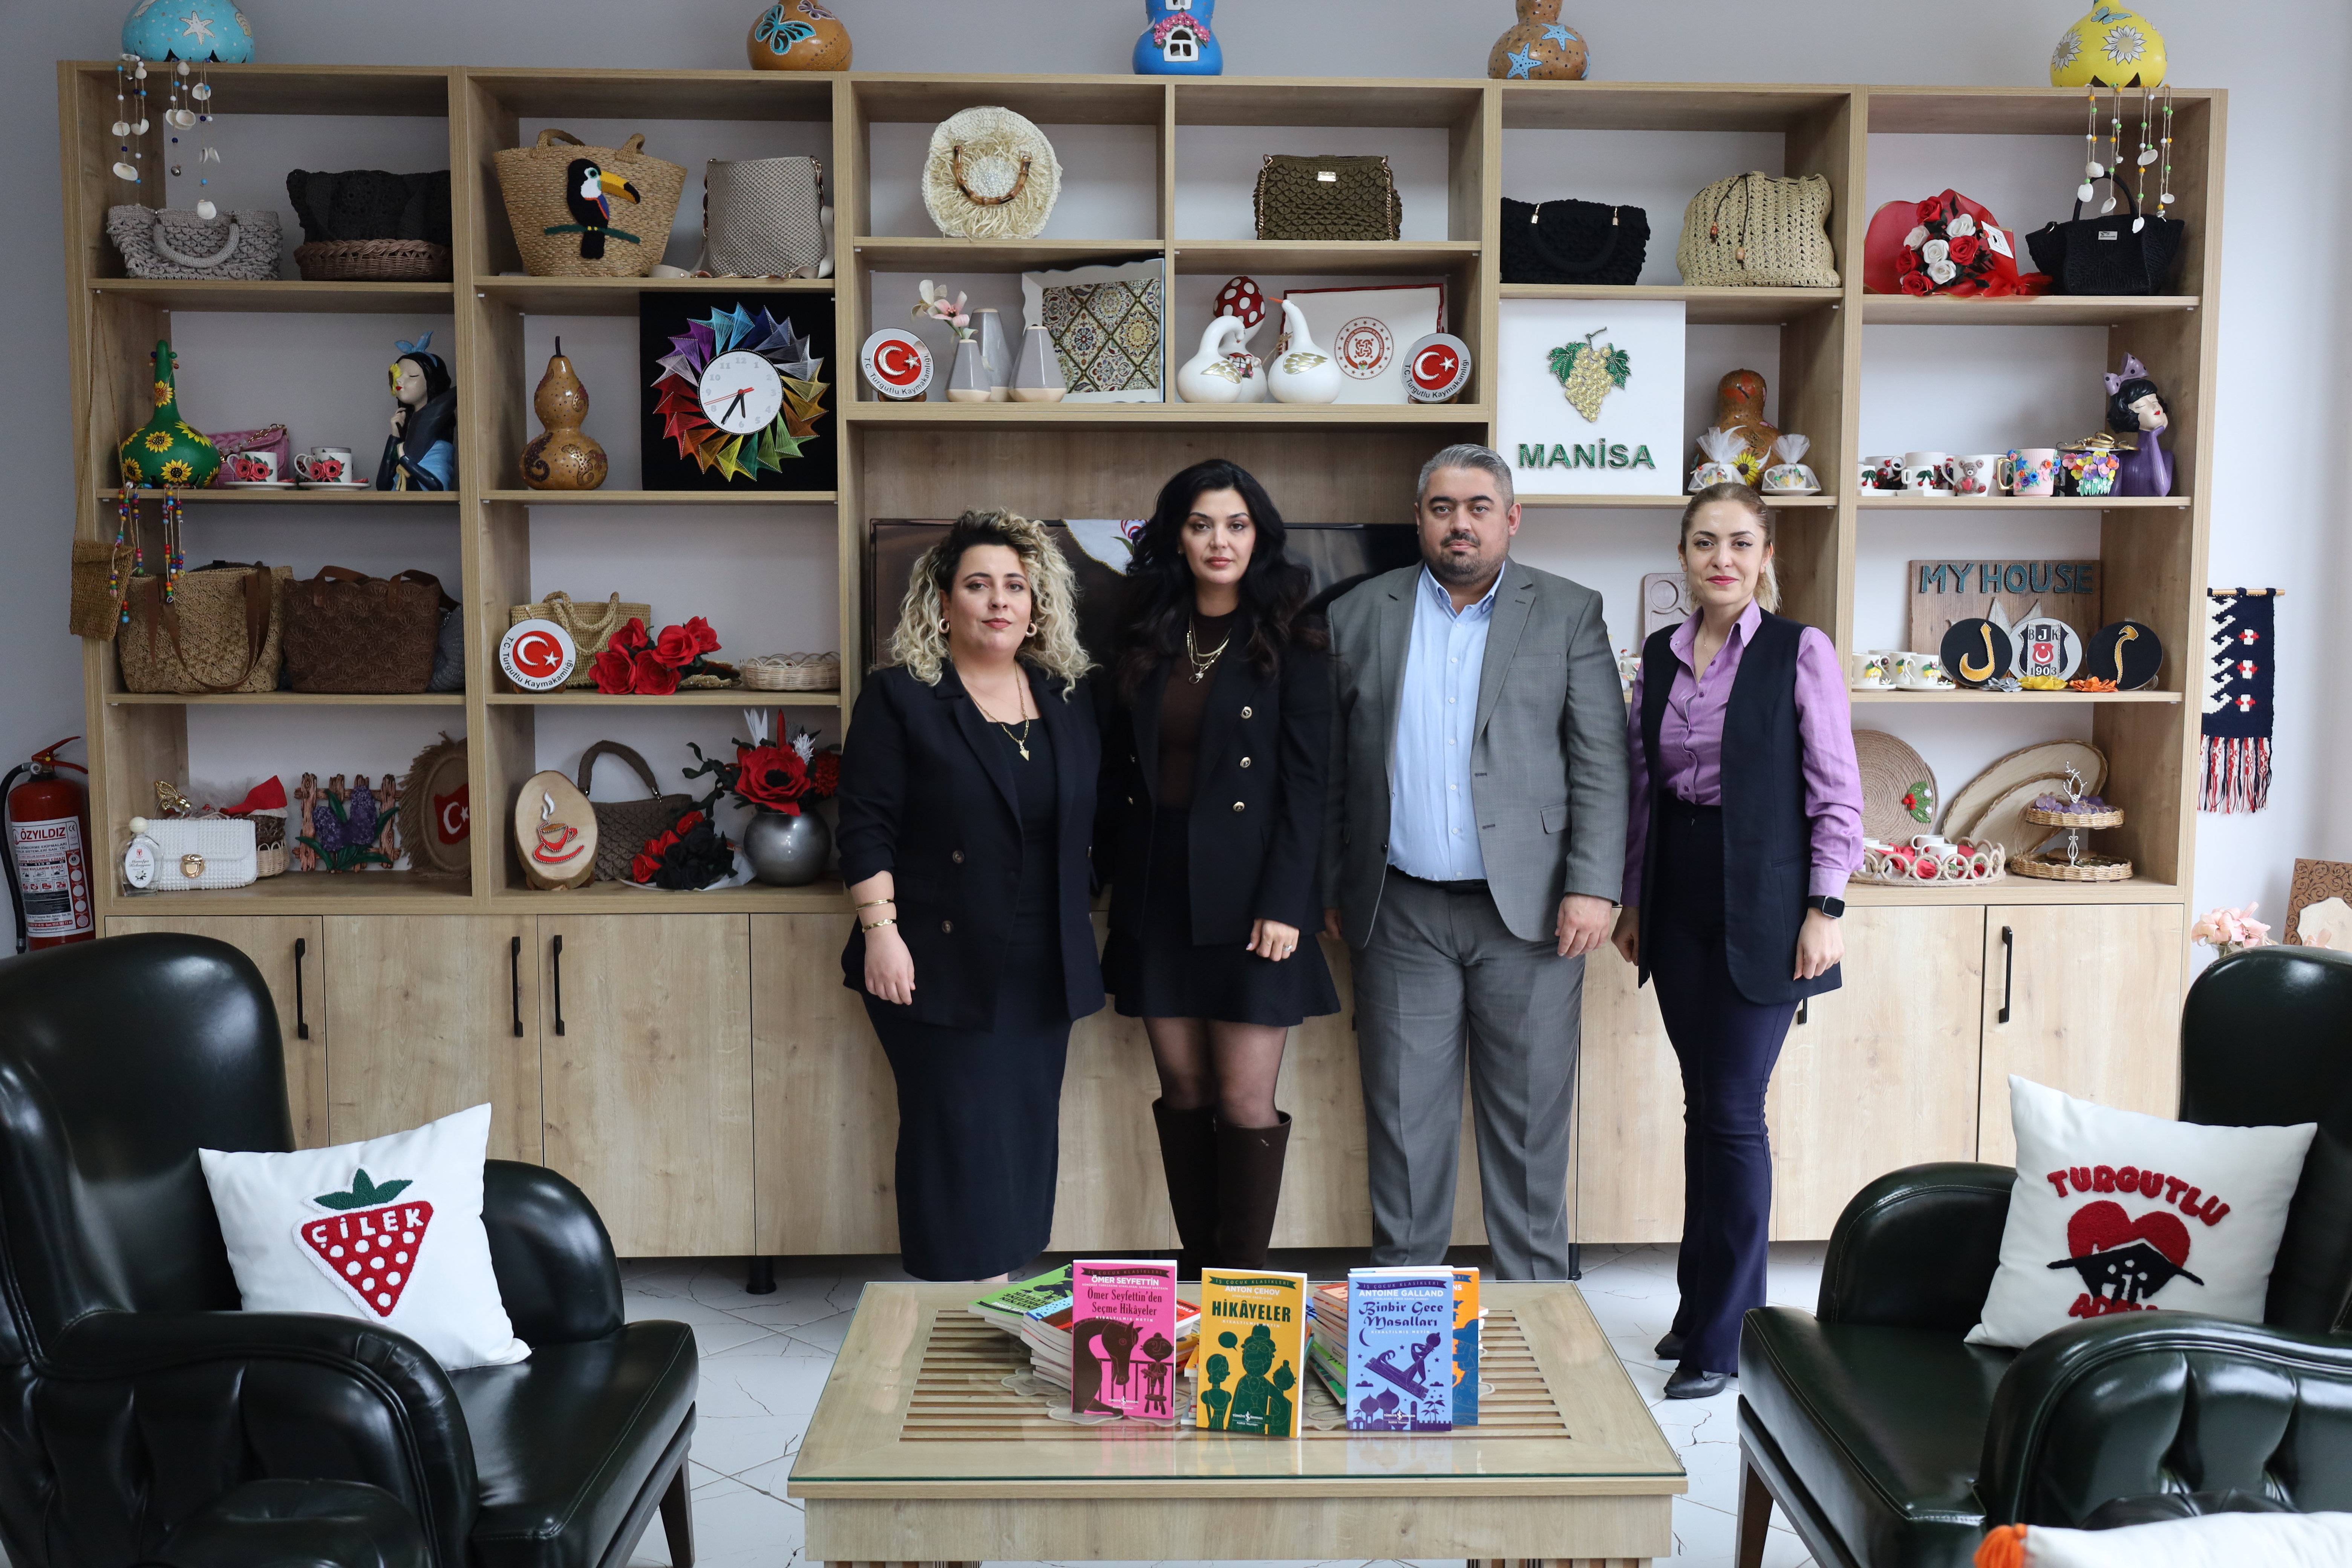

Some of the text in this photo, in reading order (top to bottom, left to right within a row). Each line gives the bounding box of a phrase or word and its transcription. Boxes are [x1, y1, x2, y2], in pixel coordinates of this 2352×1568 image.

[870, 372, 899, 394] Turgutlu
[902, 355, 931, 395] Kaymakamlığı
[1406, 378, 1430, 398] Turgutlu
[1432, 359, 1469, 398] Kaymakamlığı
[1518, 438, 1656, 469] MANİSA
[1921, 563, 2093, 593] MY HOUSE
[2029, 629, 2059, 640] BJK
[503, 637, 573, 688] T.C. Turgutlu Kaymakamlığı
[2030, 667, 2056, 675] 1903
[21, 827, 66, 840] ÖZYILDIZ
[2047, 1164, 2230, 1227] TURGUTLU
[312, 1208, 424, 1249] ÇİLEK
[1092, 1274, 1159, 1286] ÖMER SEYFETTİN
[1088, 1287, 1162, 1303] Ömer Seyfettin'den
[991, 1301, 1012, 1309] VERNE
[1092, 1302, 1157, 1316] Seçme Hikâyeler
[1212, 1298, 1291, 1323] HİKÂYELER
[1358, 1301, 1406, 1315] Binbir
[1412, 1302, 1443, 1315] Gece
[1364, 1315, 1437, 1329] Masalları
